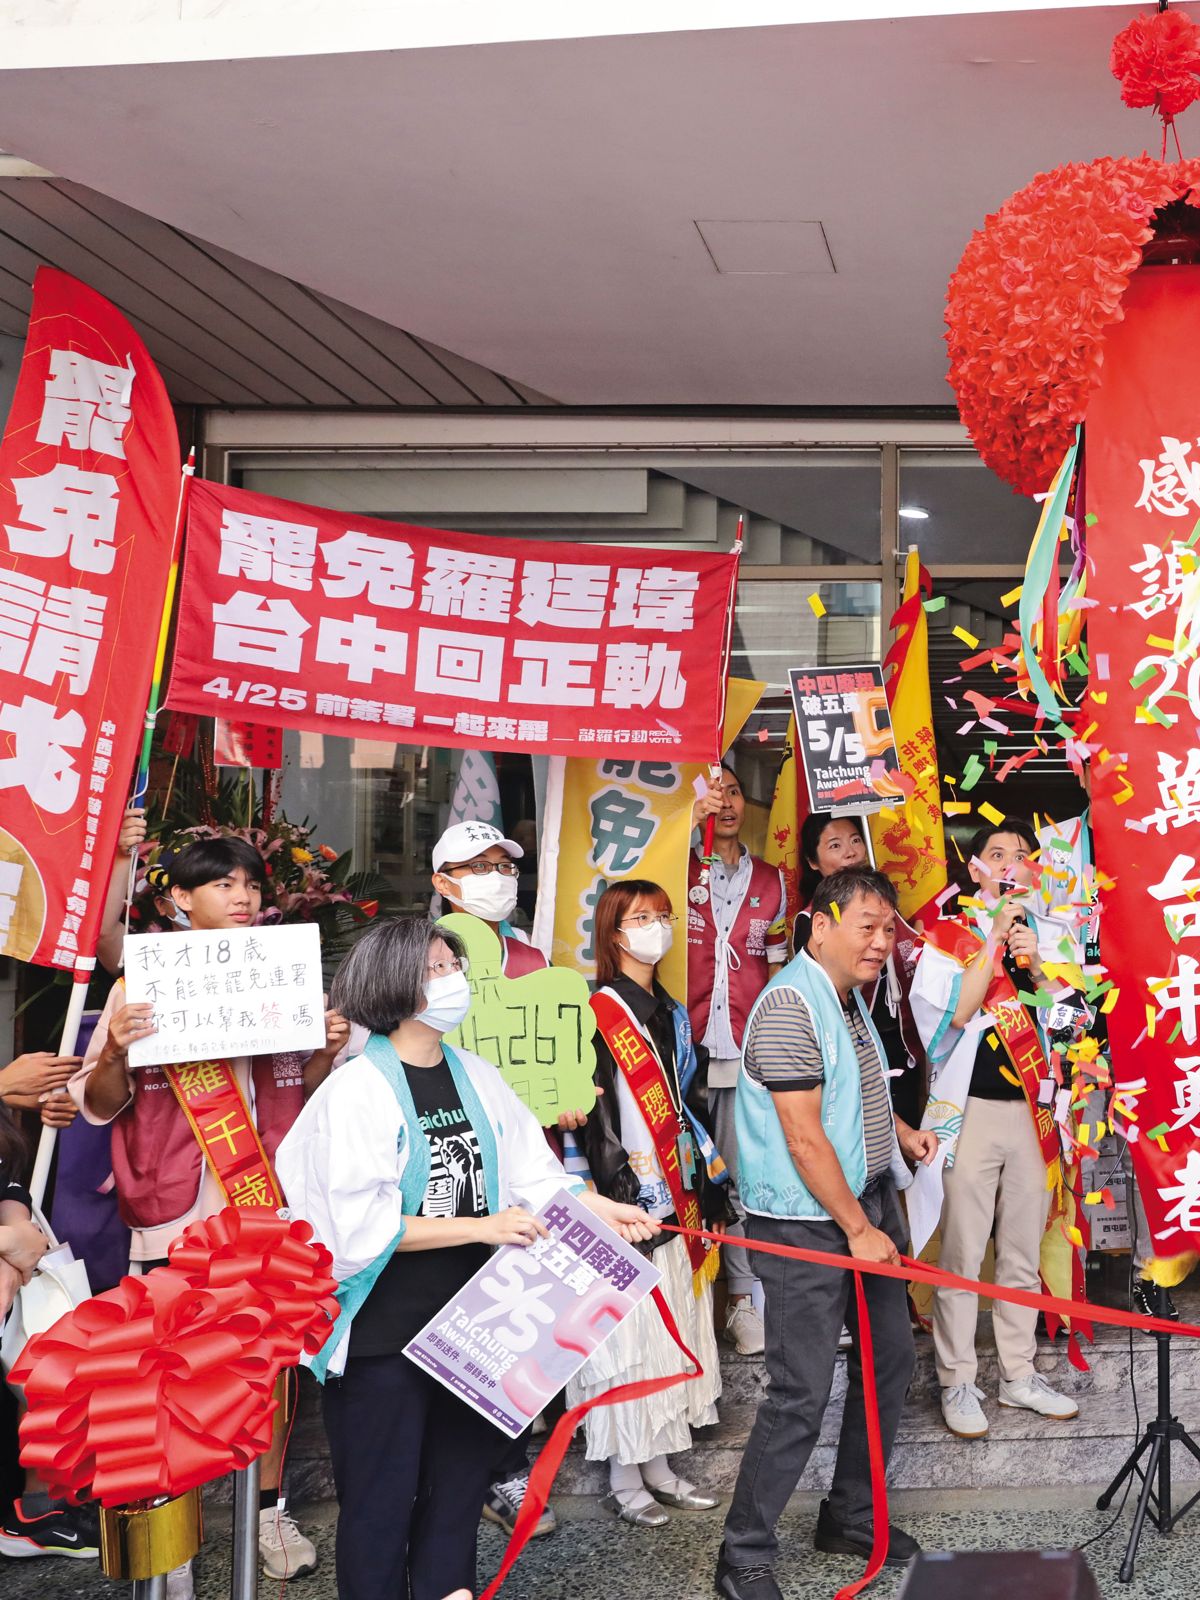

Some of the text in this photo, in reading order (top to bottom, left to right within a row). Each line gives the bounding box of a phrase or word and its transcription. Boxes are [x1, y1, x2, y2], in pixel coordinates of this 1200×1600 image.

[218, 508, 700, 633] 罷免羅廷瑋
[212, 591, 687, 710] 台中回正軌
[202, 676, 549, 742] 4/25 前簽署 一起來罷
[578, 728, 648, 744] 敲羅行動
[807, 720, 867, 764] 5/5
[814, 765, 872, 780] Taichung
[135, 936, 267, 971] 我才18歲
[418, 1108, 466, 1131] aichu
[543, 1203, 641, 1292] 中四廢翔
[436, 1320, 506, 1381] Awakening
[449, 1305, 520, 1371] Taichung
